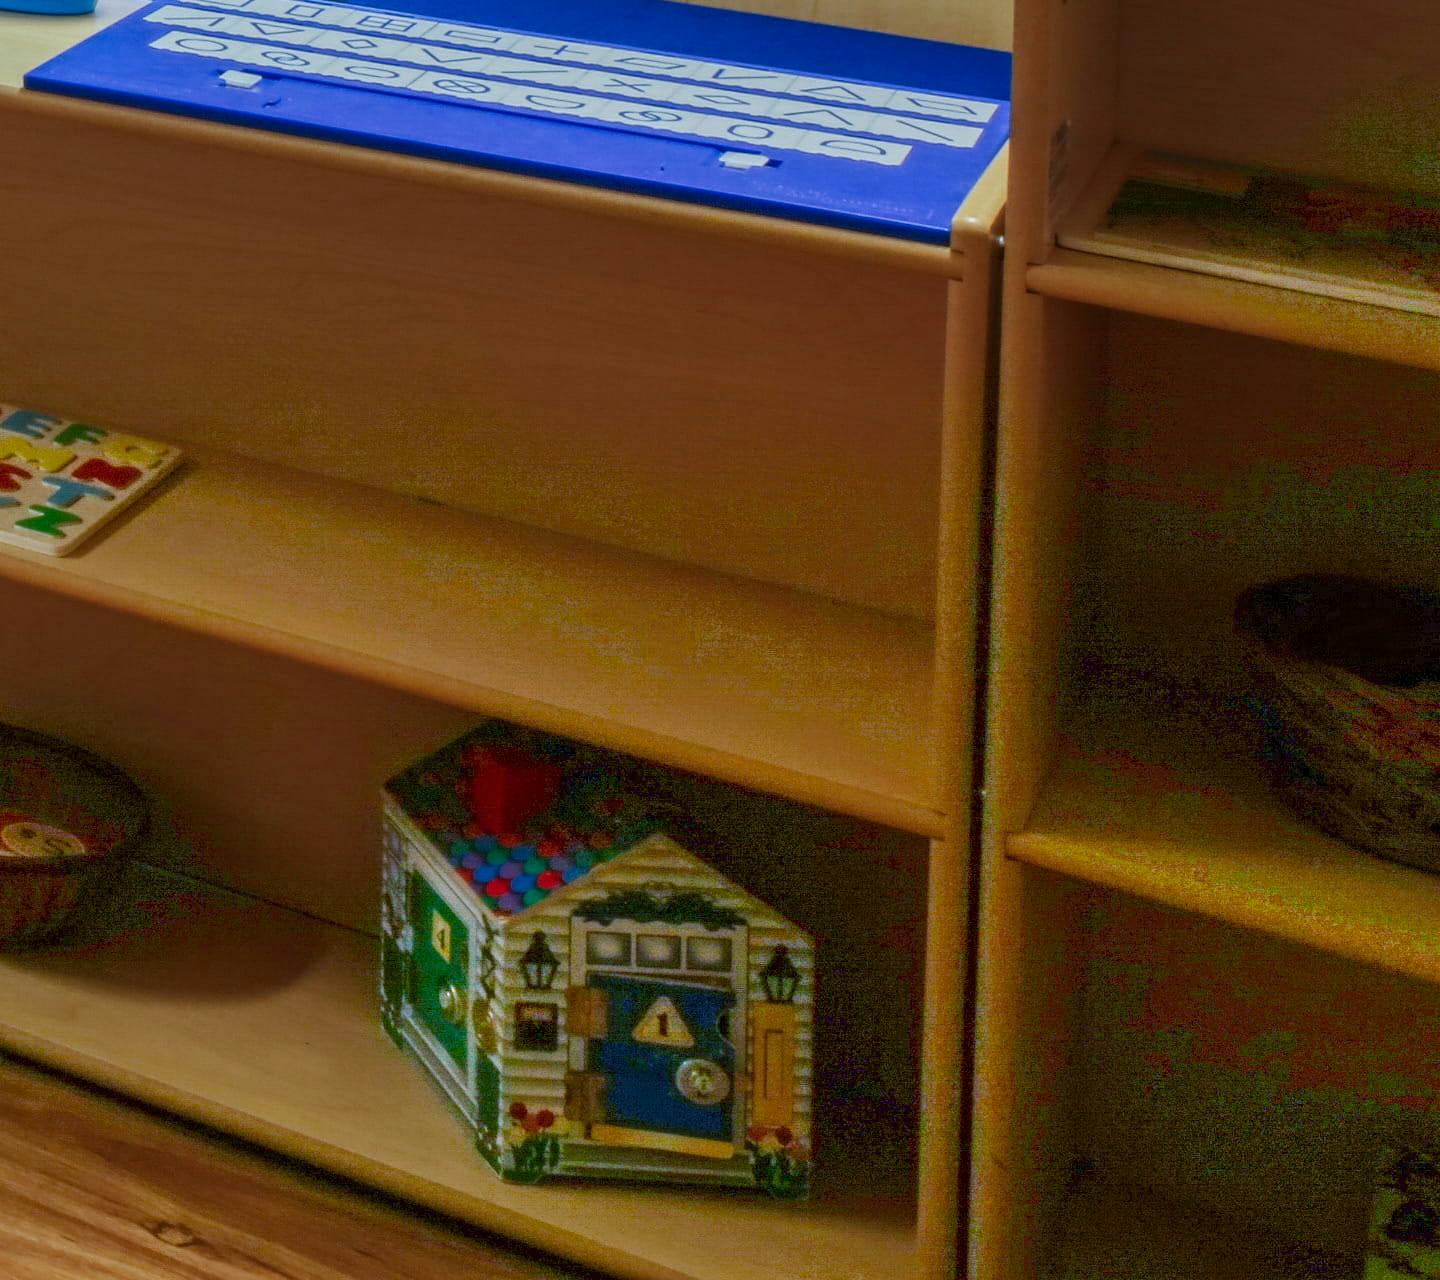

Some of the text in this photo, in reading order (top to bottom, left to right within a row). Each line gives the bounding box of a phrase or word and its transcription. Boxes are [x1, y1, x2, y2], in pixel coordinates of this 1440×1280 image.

[53, 423, 109, 446] F
[42, 476, 116, 508] T
[14, 504, 83, 538] Z
[436, 928, 446, 950] 4
[657, 1011, 670, 1038] 1
